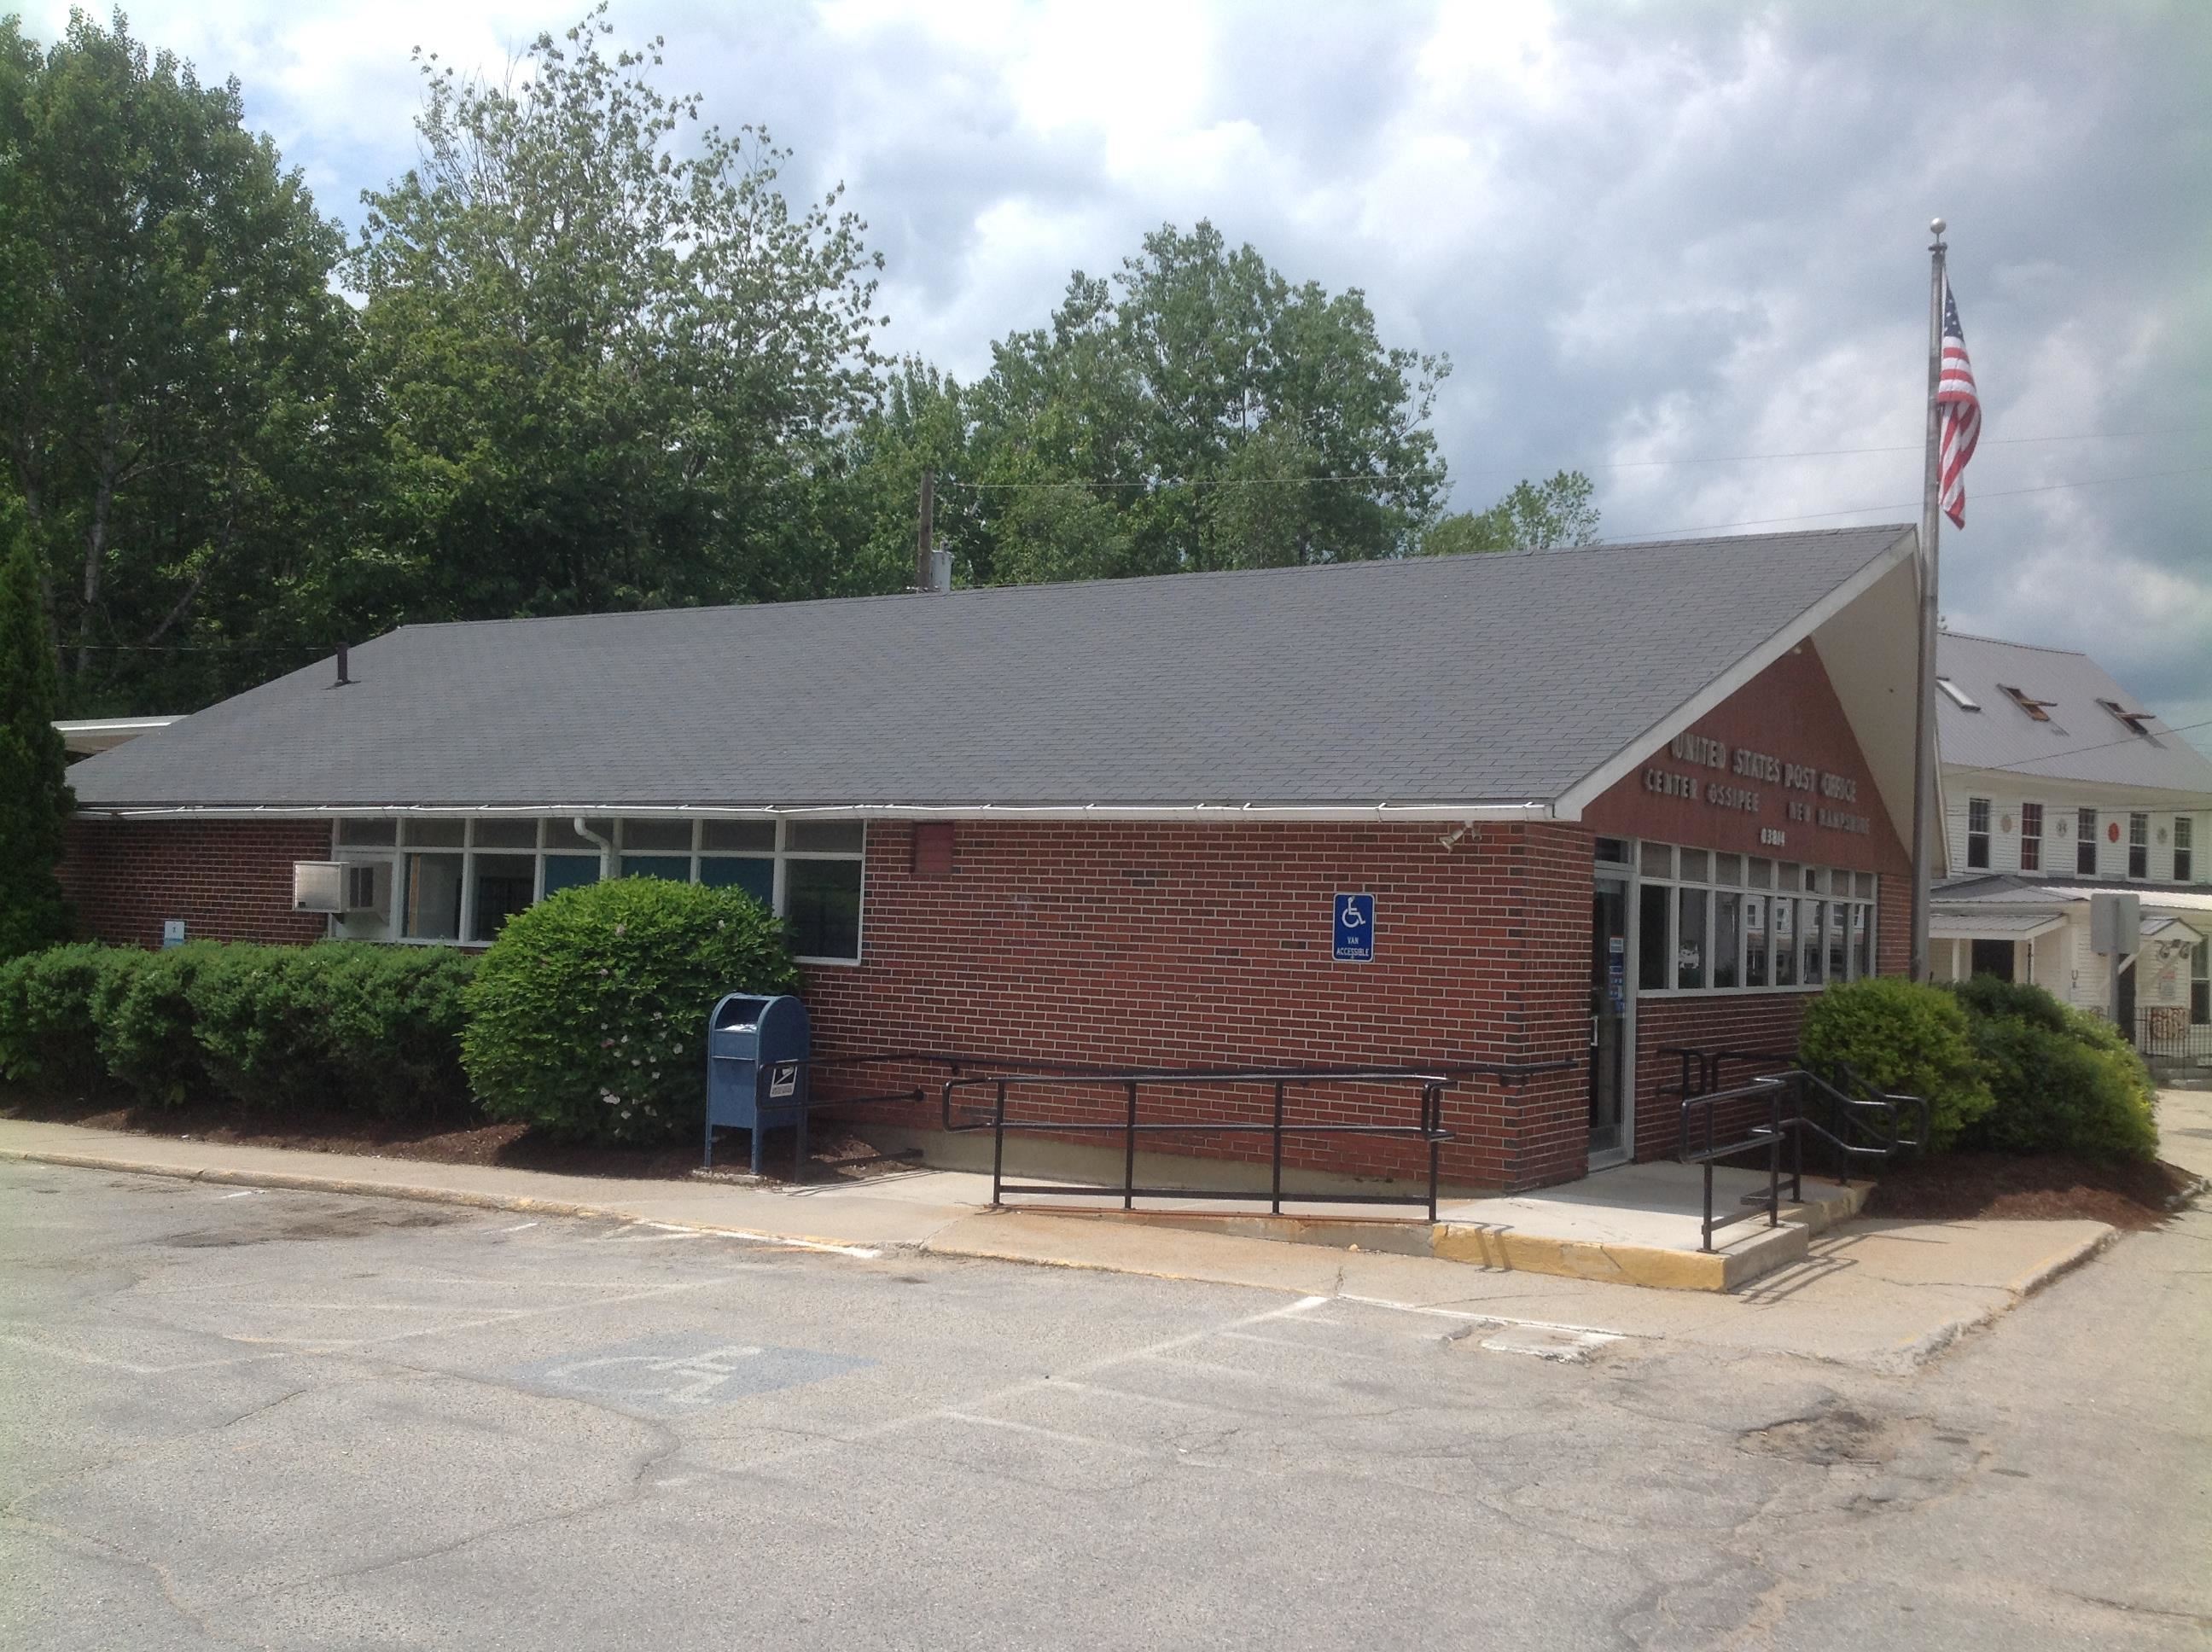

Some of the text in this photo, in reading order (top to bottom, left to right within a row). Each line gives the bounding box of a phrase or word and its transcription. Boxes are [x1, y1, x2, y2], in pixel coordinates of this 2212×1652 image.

[1670, 731, 1857, 803] UNITED STATES POST OFFICE
[1644, 769, 1698, 800] CENTER
[1708, 783, 1759, 811] OSSIPEE
[1788, 801, 1811, 822] NEW
[1761, 827, 1785, 846] 03814
[1347, 936, 1359, 945] VAN
[1336, 947, 1370, 957] ACCESSIBLE
